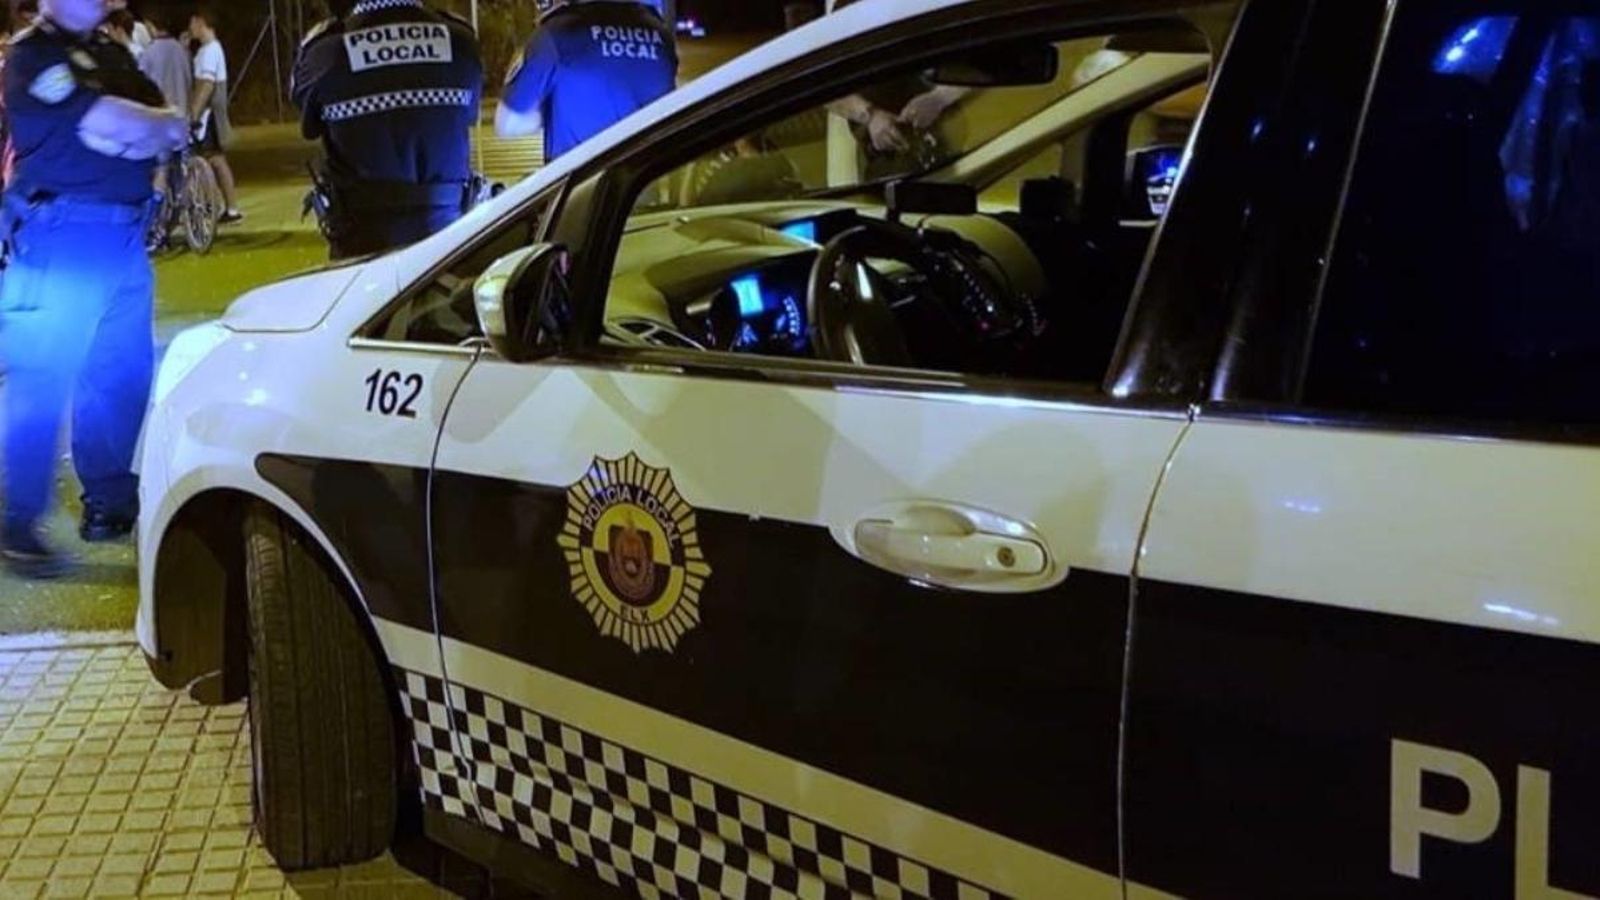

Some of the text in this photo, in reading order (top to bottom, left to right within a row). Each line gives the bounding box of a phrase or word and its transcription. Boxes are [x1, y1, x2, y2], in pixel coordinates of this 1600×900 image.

[363, 45, 440, 64] LOCAL
[602, 40, 658, 59] LOCAL
[365, 368, 423, 419] 162
[583, 485, 680, 547] POLICIA LOCAL
[620, 605, 650, 623] ELX
